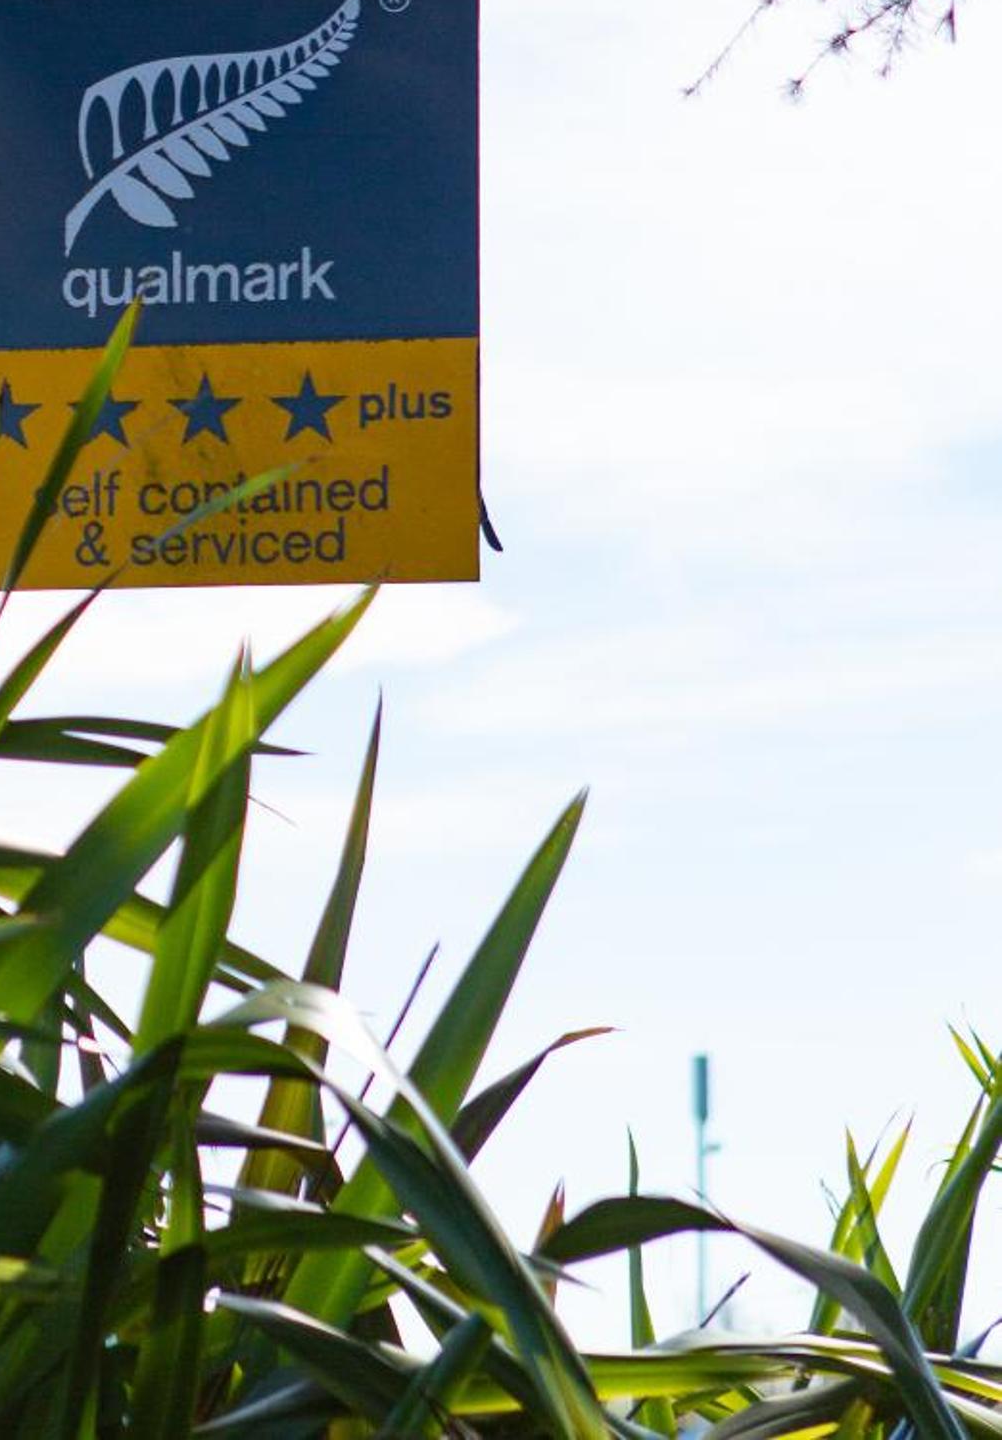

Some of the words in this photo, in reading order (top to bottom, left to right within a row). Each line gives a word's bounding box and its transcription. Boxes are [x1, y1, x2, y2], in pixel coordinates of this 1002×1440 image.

[62, 247, 336, 318] qualmark
[358, 383, 452, 427] plus
[35, 470, 121, 519] elf
[74, 521, 111, 567] &
[130, 517, 347, 566] serviced
